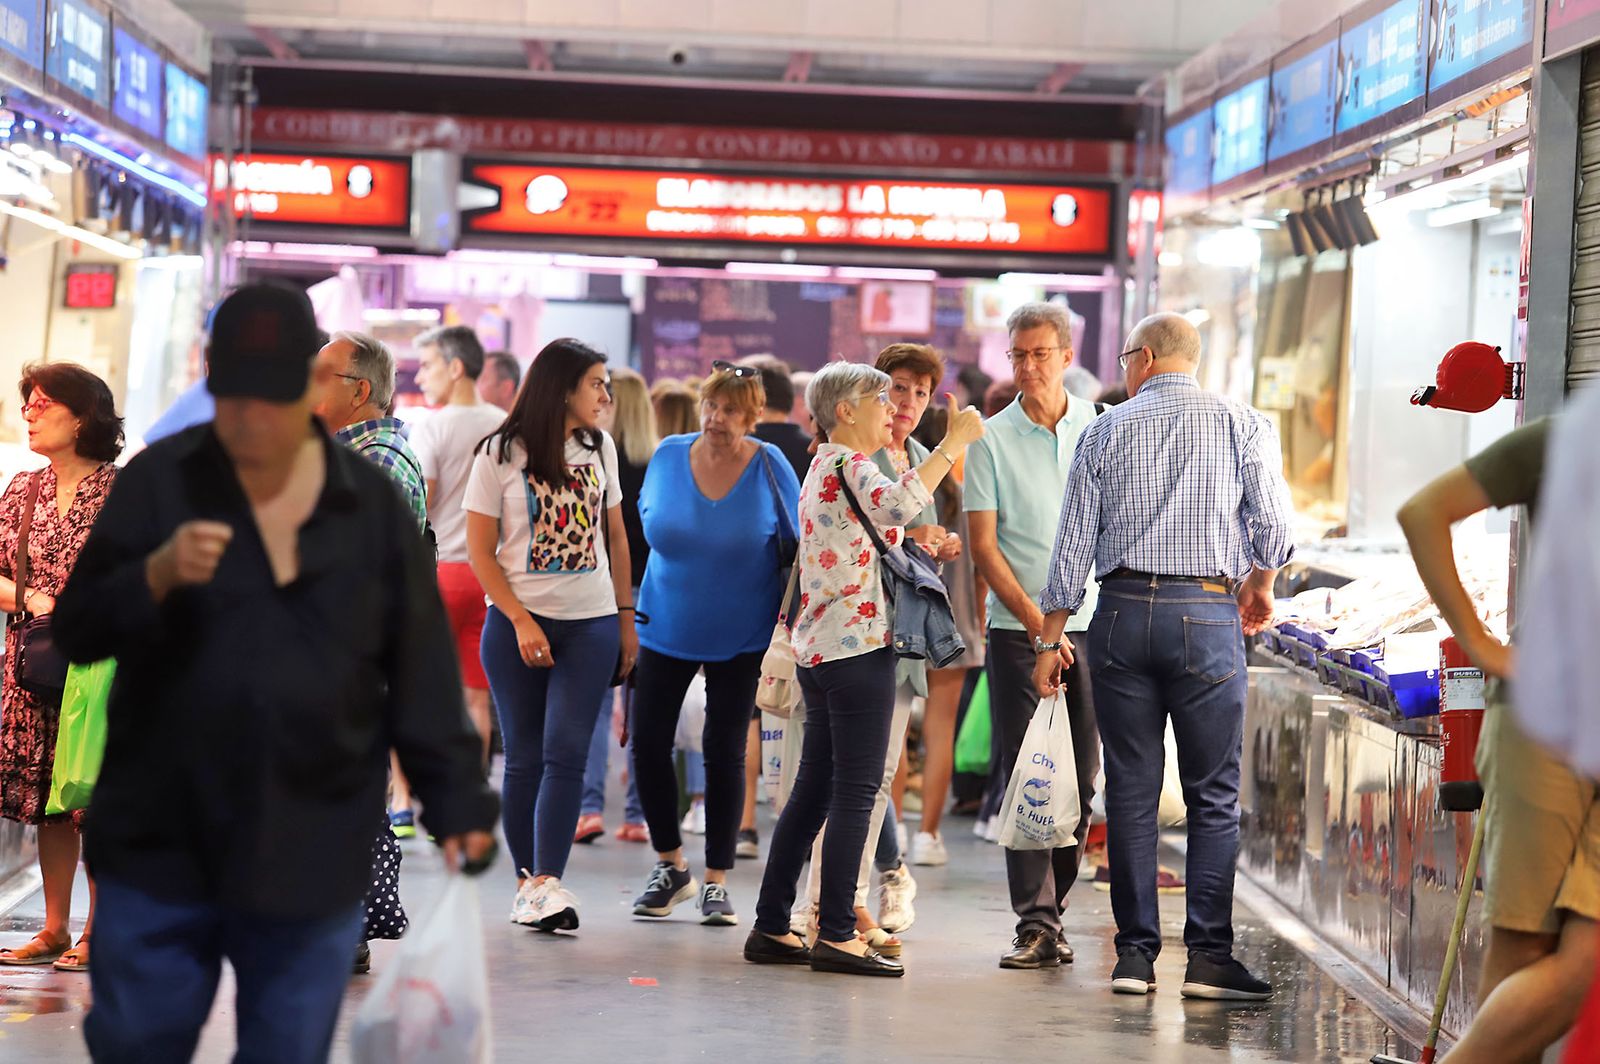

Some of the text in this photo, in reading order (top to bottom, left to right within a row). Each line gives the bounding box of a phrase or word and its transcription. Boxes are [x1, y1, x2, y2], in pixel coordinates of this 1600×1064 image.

[436, 119, 535, 147] OLLO
[557, 126, 664, 152] PERDIZ
[694, 131, 812, 159] CONEJO
[972, 139, 1075, 168] JABALÍ
